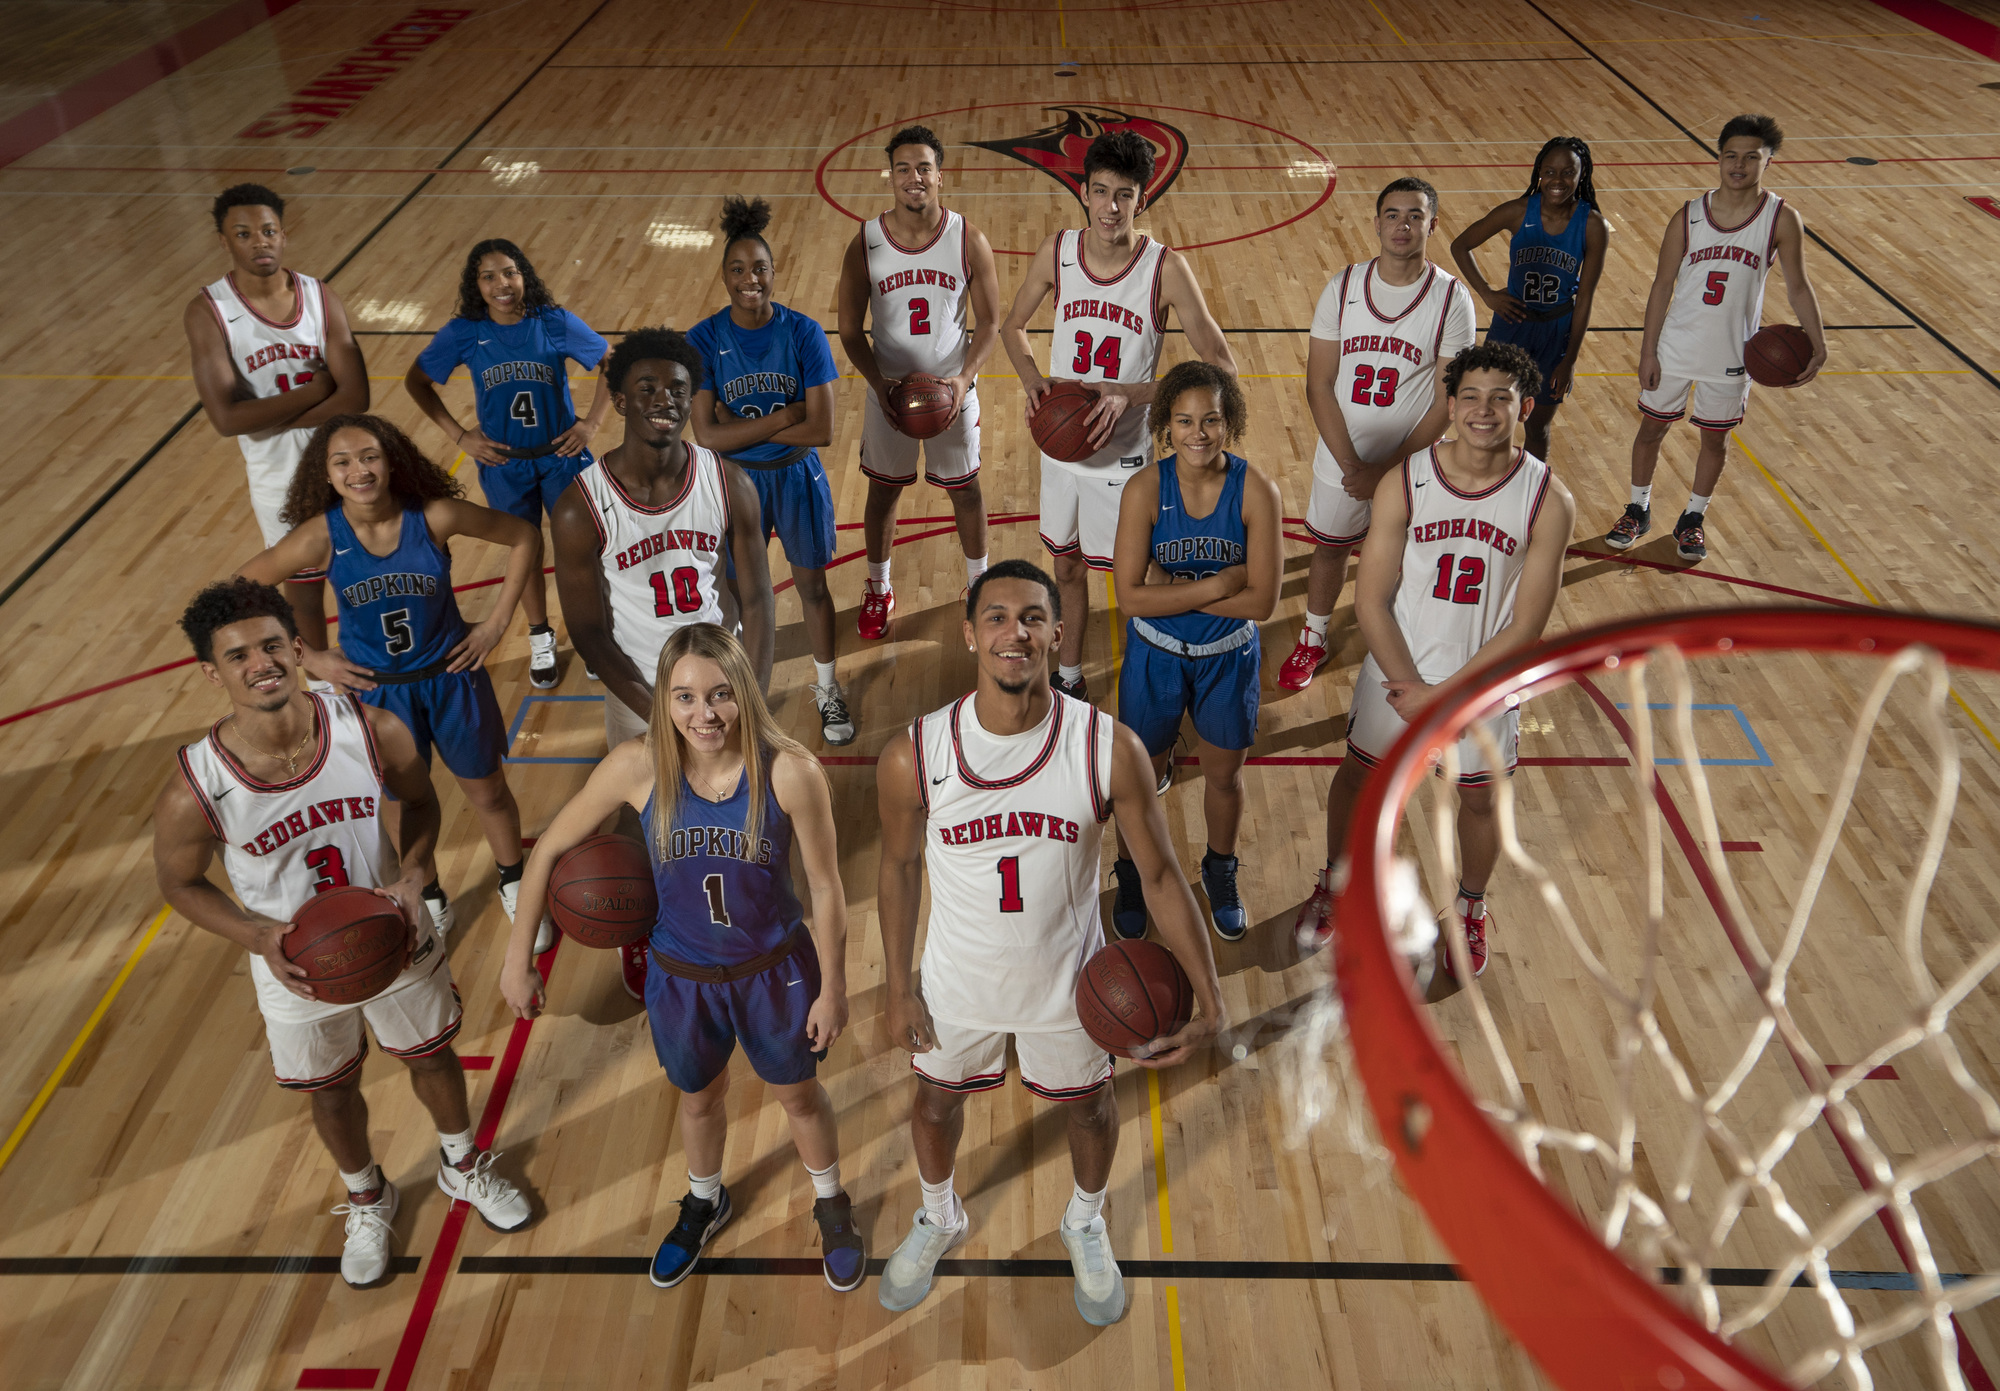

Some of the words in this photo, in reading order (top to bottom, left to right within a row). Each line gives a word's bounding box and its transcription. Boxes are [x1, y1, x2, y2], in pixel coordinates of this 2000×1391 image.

[235, 8, 478, 139] REDHAWKS
[1515, 246, 1577, 273] HOPKINS
[1688, 245, 1760, 270] REDHAWKS
[878, 269, 956, 296] REDHAWKS
[1523, 271, 1561, 304] 22
[1702, 271, 1729, 306] 5
[908, 297, 931, 335] 2
[1063, 299, 1143, 335] REDHAWKS
[1072, 330, 1121, 380] 34
[1342, 335, 1422, 366] REDHAWKS
[482, 361, 553, 391] HOPKINS
[724, 372, 797, 404] HOPKINS
[1350, 364, 1400, 407] 23
[510, 391, 537, 427] 4
[615, 529, 717, 571] REDHAWKS
[1156, 536, 1242, 564] HOPKINS
[1414, 518, 1517, 556] REDHAWKS
[342, 573, 436, 607] HOPKINS
[648, 566, 703, 618] 10
[1432, 553, 1485, 605] 12
[380, 608, 414, 656] 5
[241, 797, 374, 857] REDHAWKS
[939, 812, 1079, 845] REDHAWKS
[304, 844, 350, 894] 3
[997, 856, 1024, 913] 1
[702, 873, 731, 927] 1
